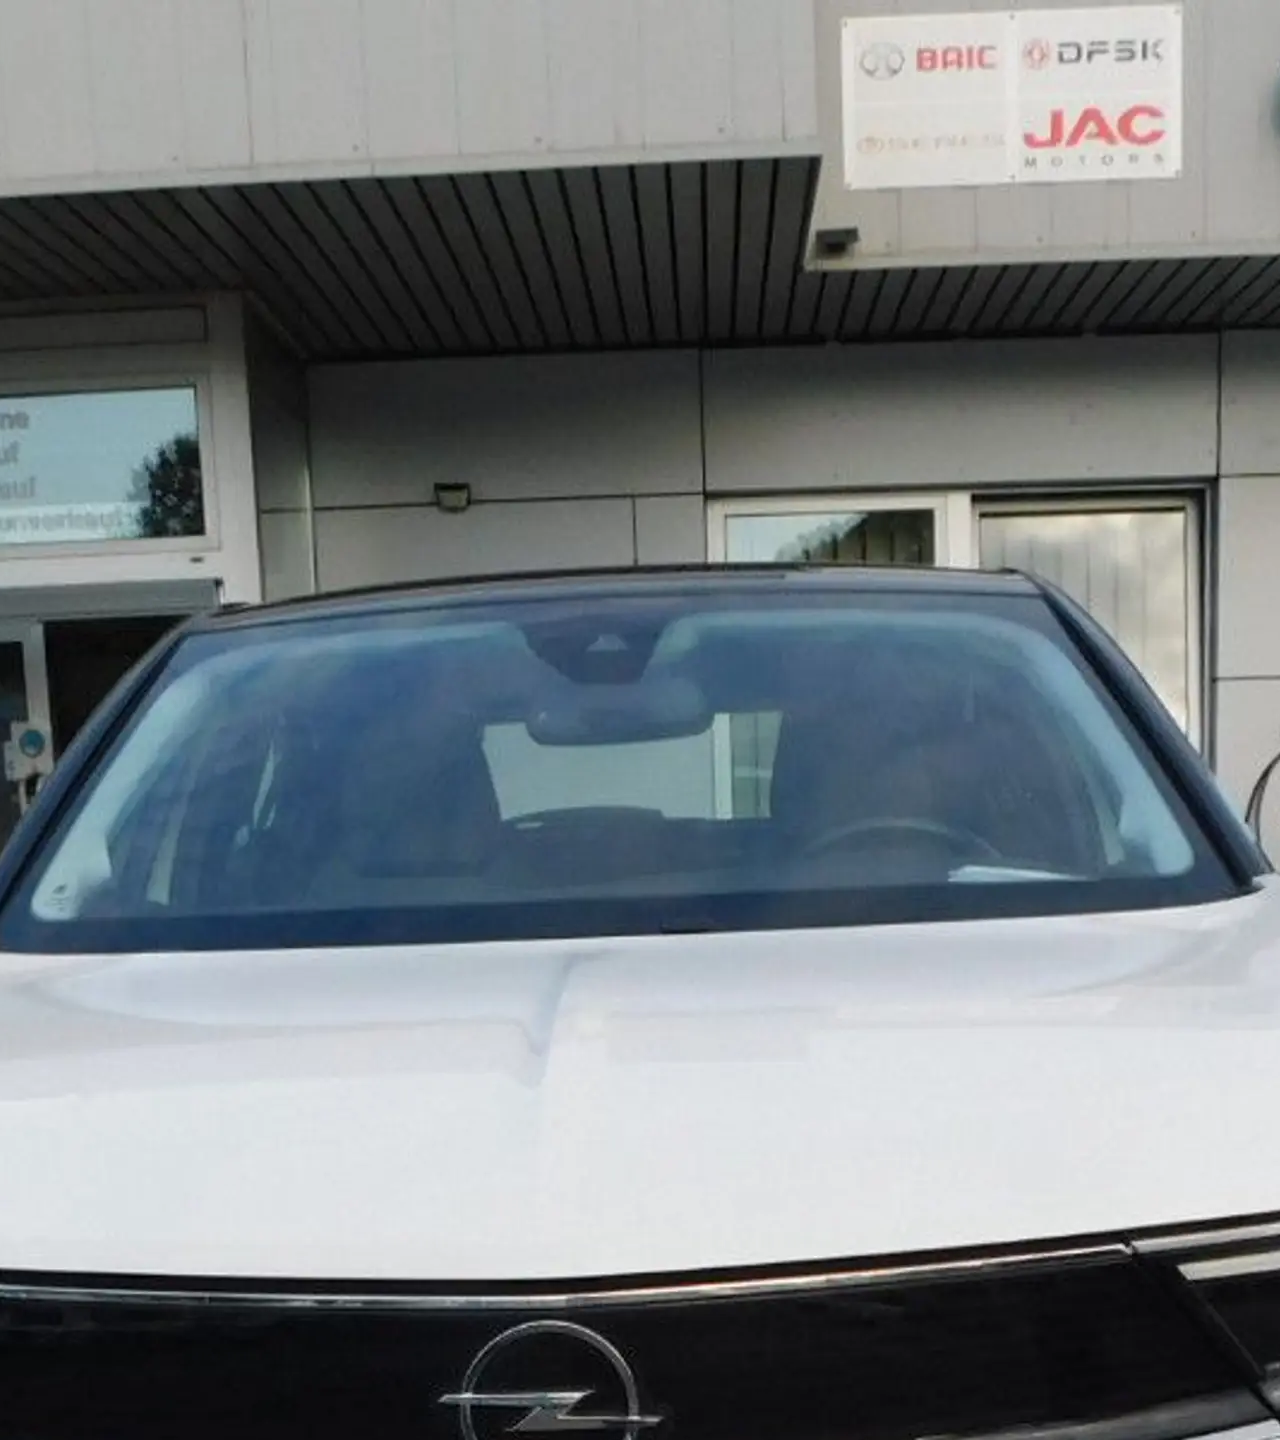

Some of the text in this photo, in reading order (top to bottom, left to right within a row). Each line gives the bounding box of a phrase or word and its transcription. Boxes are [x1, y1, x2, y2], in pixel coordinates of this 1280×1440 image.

[916, 45, 998, 72] BAIC
[1057, 39, 1165, 64] DFSK
[1023, 104, 1166, 149] JAC
[1024, 153, 1165, 169] MOTORS
